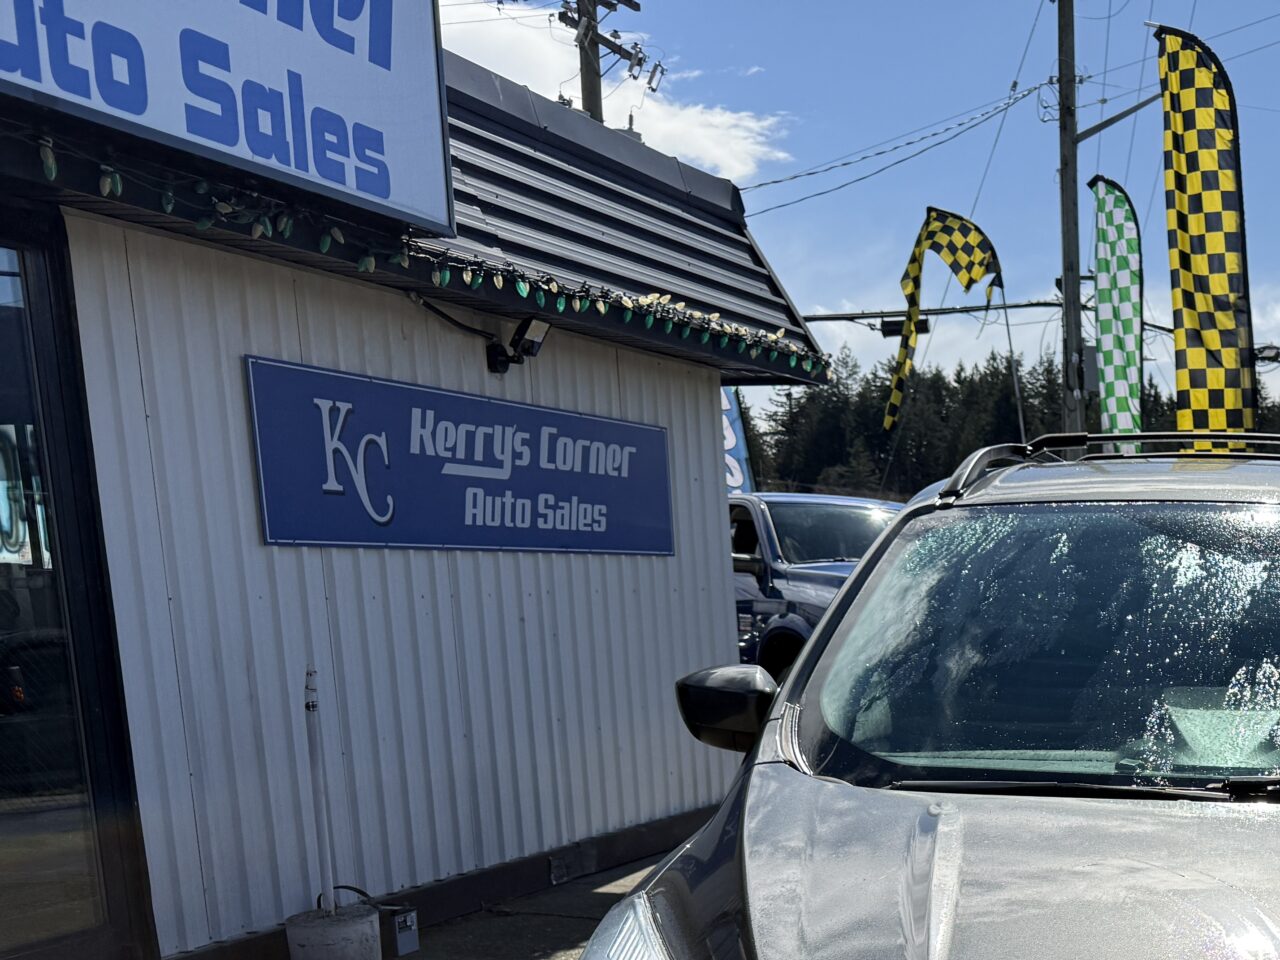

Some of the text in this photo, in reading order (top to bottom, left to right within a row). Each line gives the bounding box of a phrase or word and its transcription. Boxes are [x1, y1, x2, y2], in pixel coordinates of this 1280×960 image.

[179, 28, 391, 199] Sales
[313, 398, 394, 524] KC
[409, 407, 637, 480] Kerry's Corner
[464, 487, 607, 532] Auto Sales
